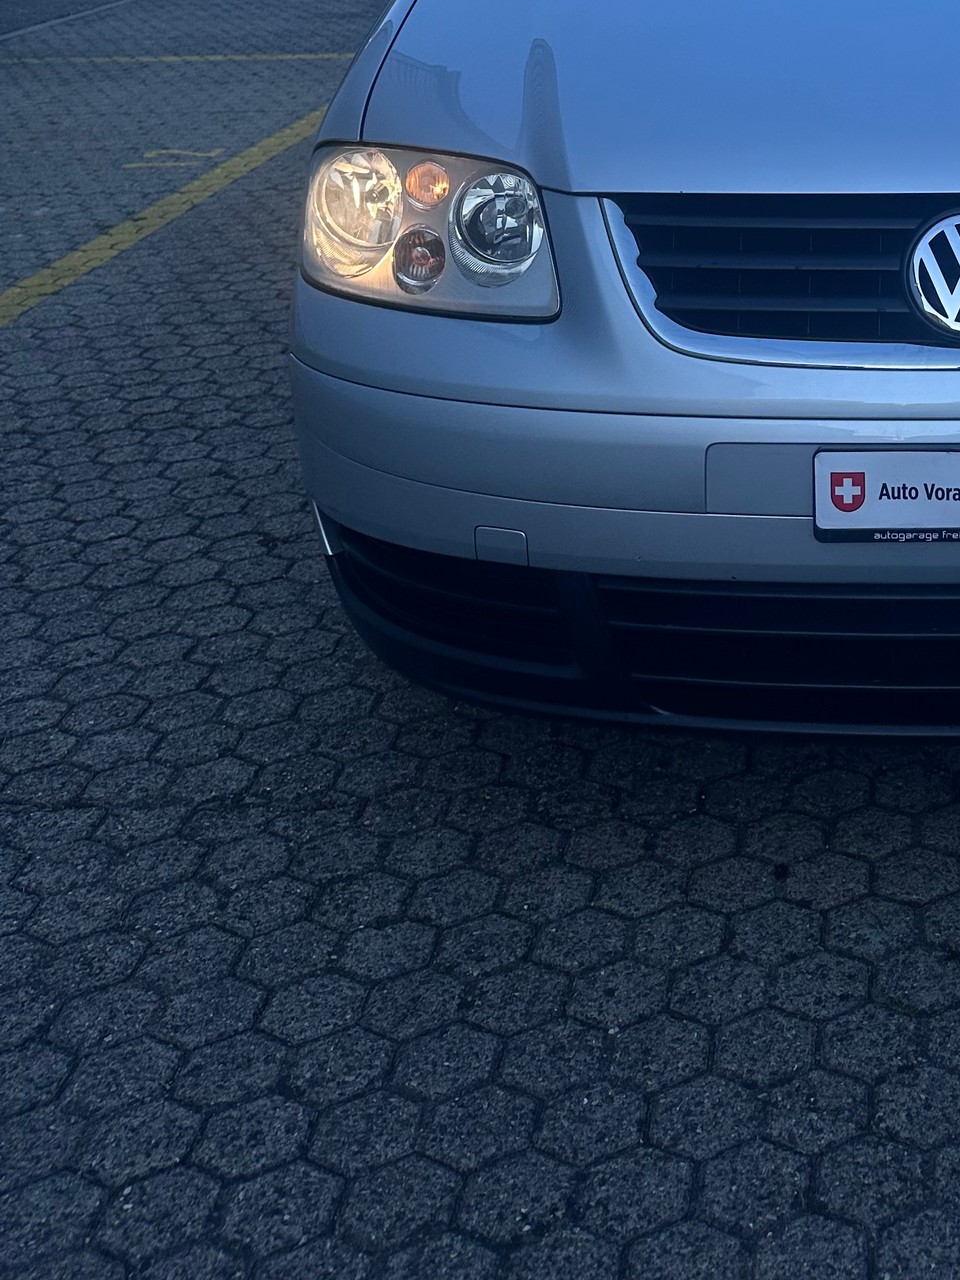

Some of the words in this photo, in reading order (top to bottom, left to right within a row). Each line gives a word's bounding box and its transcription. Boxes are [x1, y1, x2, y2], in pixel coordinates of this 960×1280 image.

[878, 482, 919, 501] Auto
[873, 531, 939, 542] autogarage
[942, 530, 960, 539] frei
